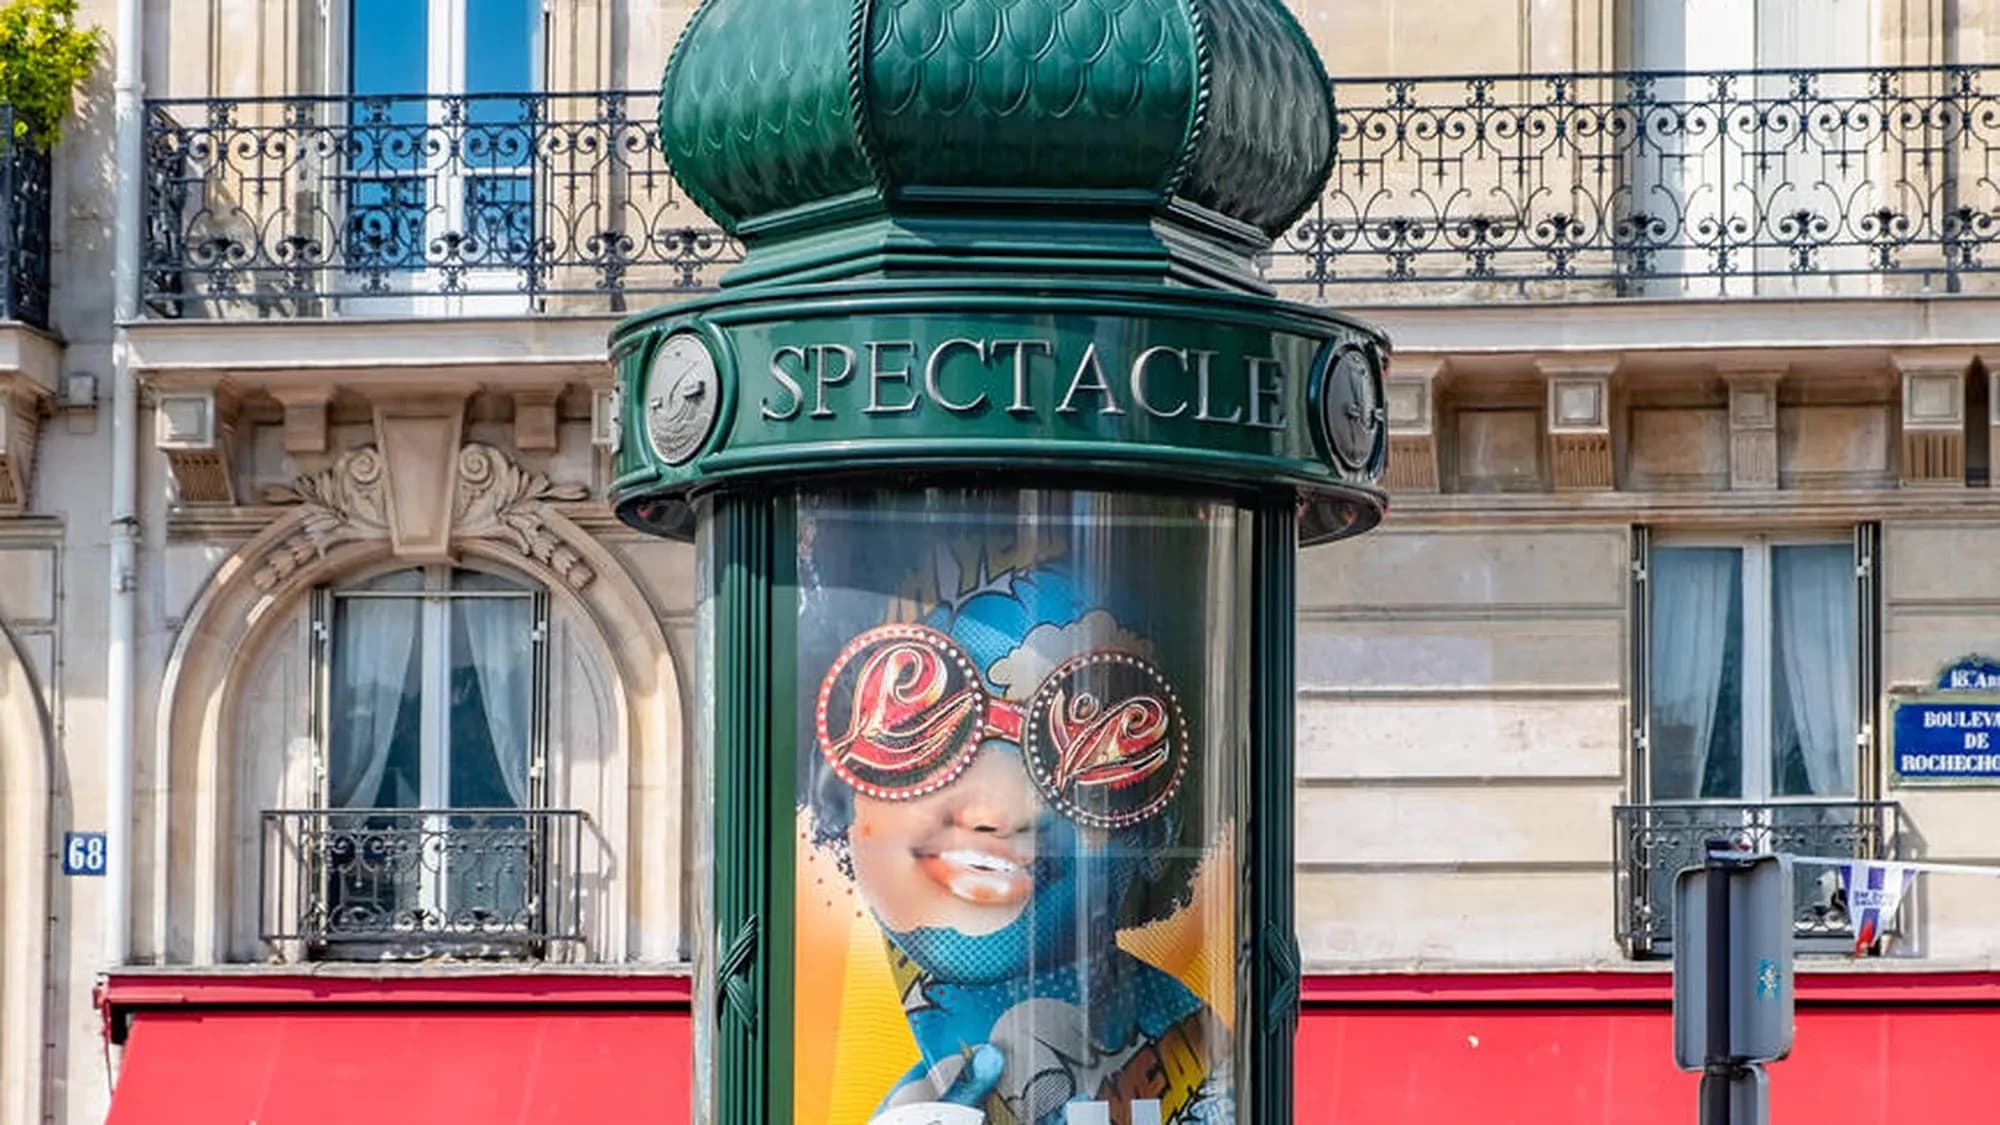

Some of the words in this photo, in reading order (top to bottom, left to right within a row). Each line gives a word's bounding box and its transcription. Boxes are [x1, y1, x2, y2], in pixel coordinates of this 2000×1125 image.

[761, 336, 1289, 430] SPECTACLE
[1964, 732, 1990, 750] DE
[69, 837, 103, 870] 68
